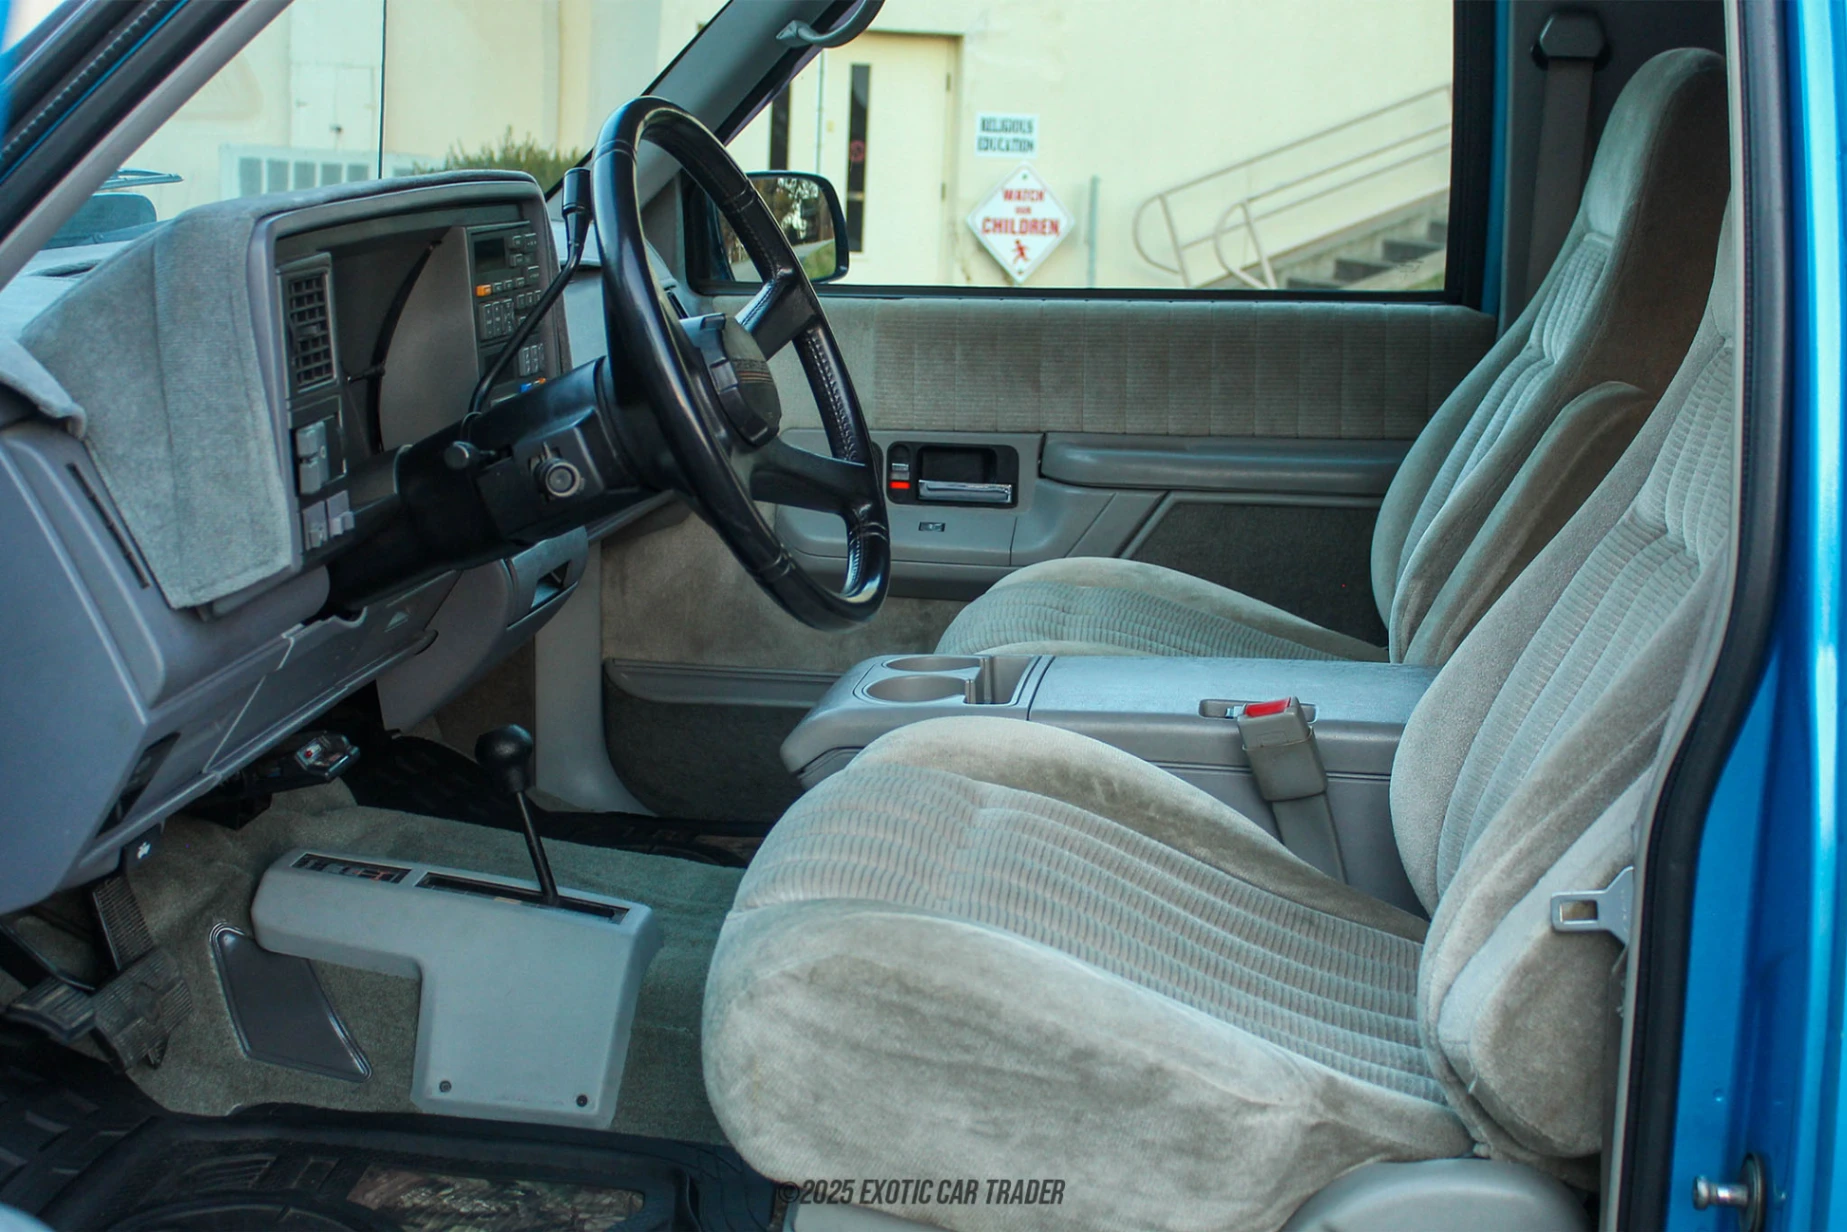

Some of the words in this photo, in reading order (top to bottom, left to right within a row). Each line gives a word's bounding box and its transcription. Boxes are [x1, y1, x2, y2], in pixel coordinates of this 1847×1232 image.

[981, 118, 1033, 133] RELIGIOUS
[977, 137, 1034, 152] EDUCATION
[1004, 190, 1044, 201] WATCH
[982, 218, 1060, 236] CHILDREN
